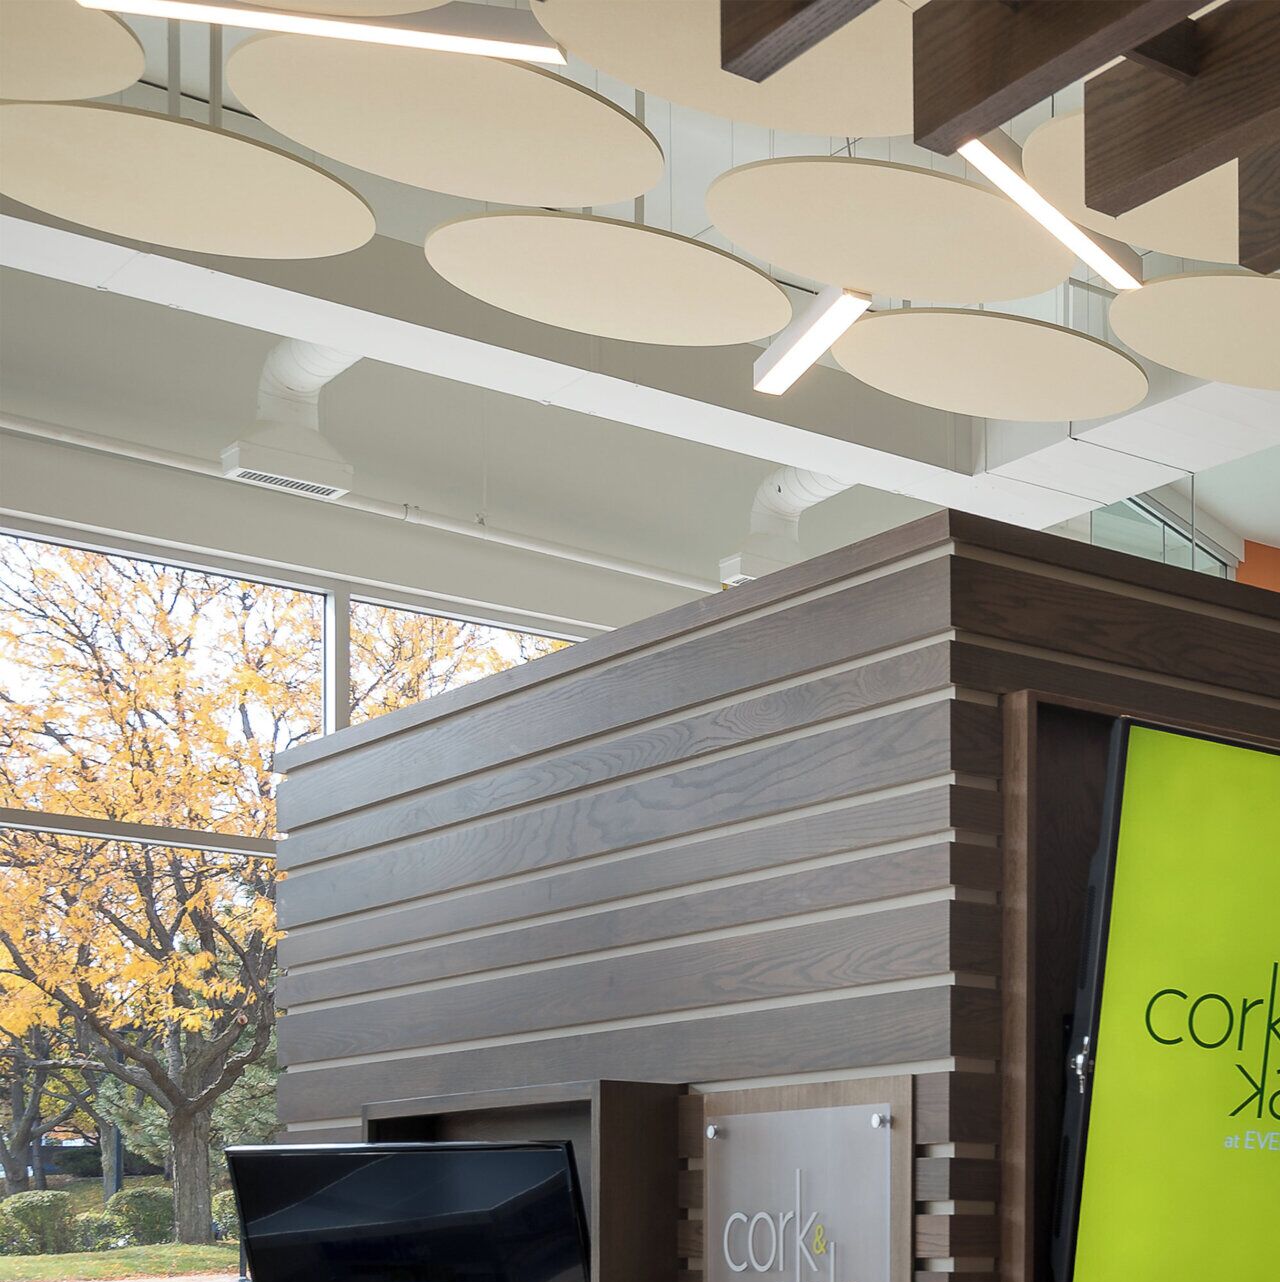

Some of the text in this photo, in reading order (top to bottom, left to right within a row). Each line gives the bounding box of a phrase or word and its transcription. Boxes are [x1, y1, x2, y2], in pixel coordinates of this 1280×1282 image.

[1223, 1134, 1240, 1149] at
[723, 1168, 828, 1273] cork &
